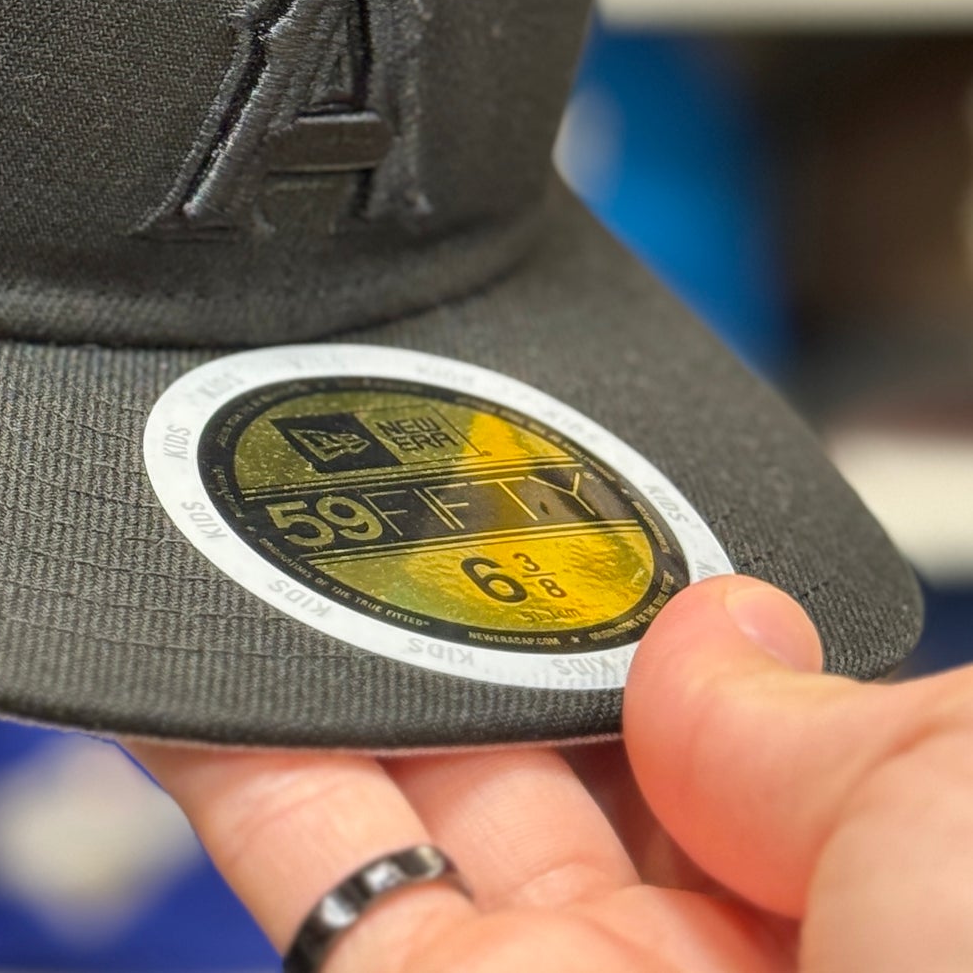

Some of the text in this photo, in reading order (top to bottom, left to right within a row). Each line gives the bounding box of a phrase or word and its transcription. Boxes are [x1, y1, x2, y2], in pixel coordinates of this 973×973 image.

[162, 424, 192, 460] KIDS
[375, 416, 442, 438] NEW
[390, 432, 459, 452] ERA
[181, 500, 228, 539] KIDS
[265, 471, 597, 547] 59FIFTY
[460, 556, 528, 604] 6
[267, 579, 332, 618] KIDS
[331, 585, 353, 600] THE
[354, 595, 383, 614] TRUE
[407, 636, 475, 666] KIDS
[467, 630, 562, 646] NEWERACAP.COM
